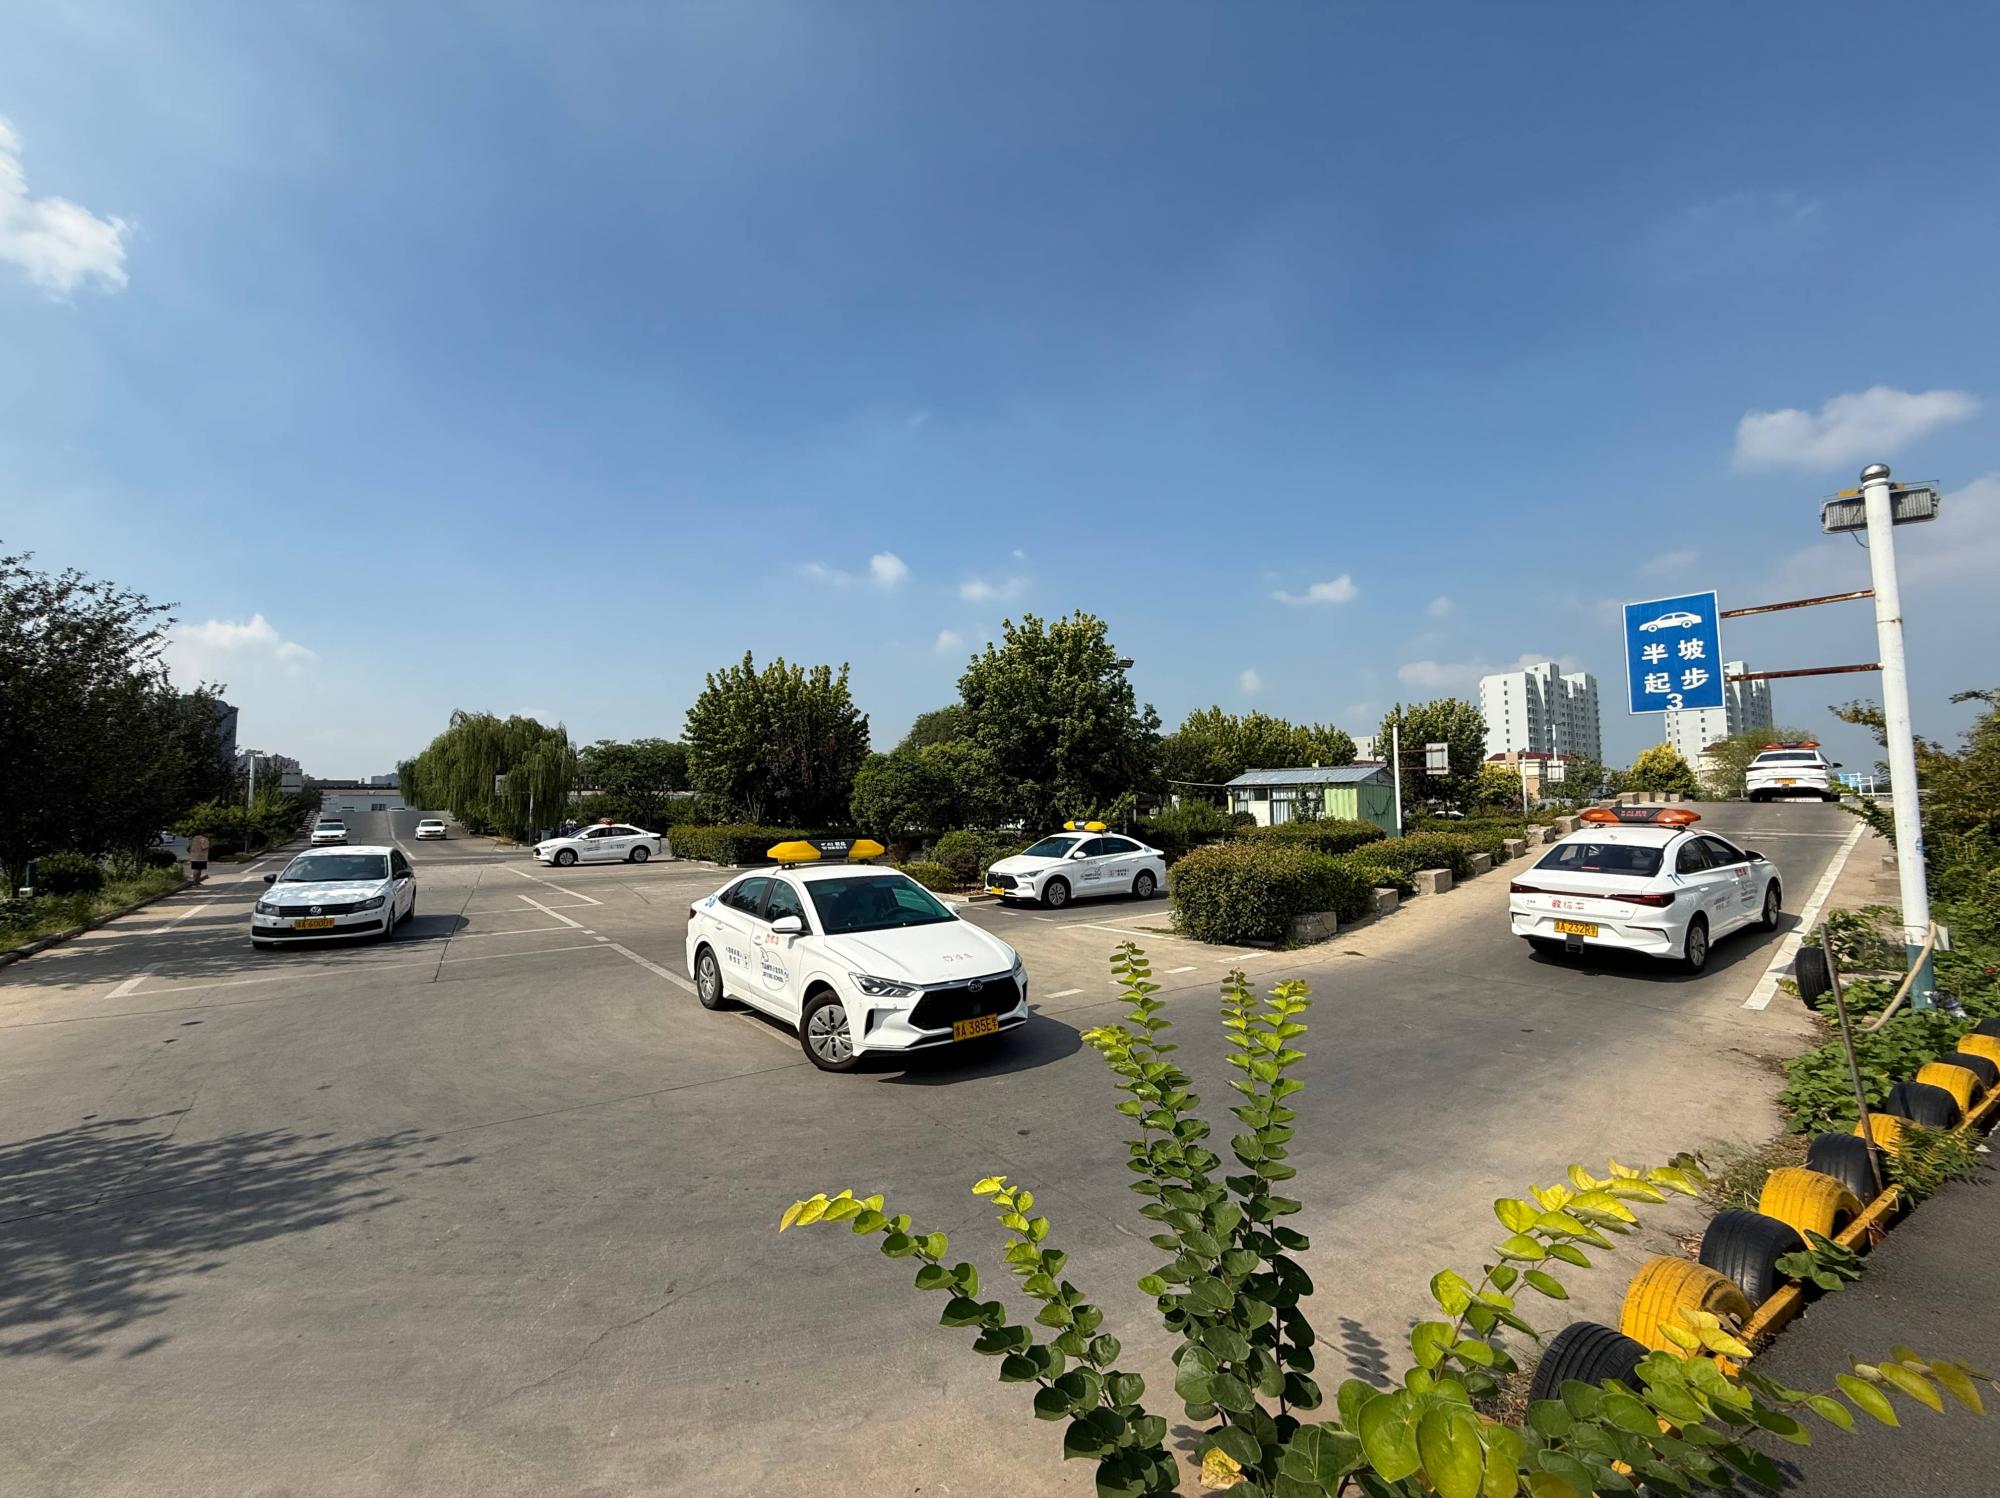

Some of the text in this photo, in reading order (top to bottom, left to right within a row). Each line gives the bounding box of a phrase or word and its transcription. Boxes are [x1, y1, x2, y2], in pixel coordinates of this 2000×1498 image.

[1641, 637, 1706, 665] 半坡
[1643, 667, 1709, 694] 起步
[1666, 692, 1683, 711] 3
